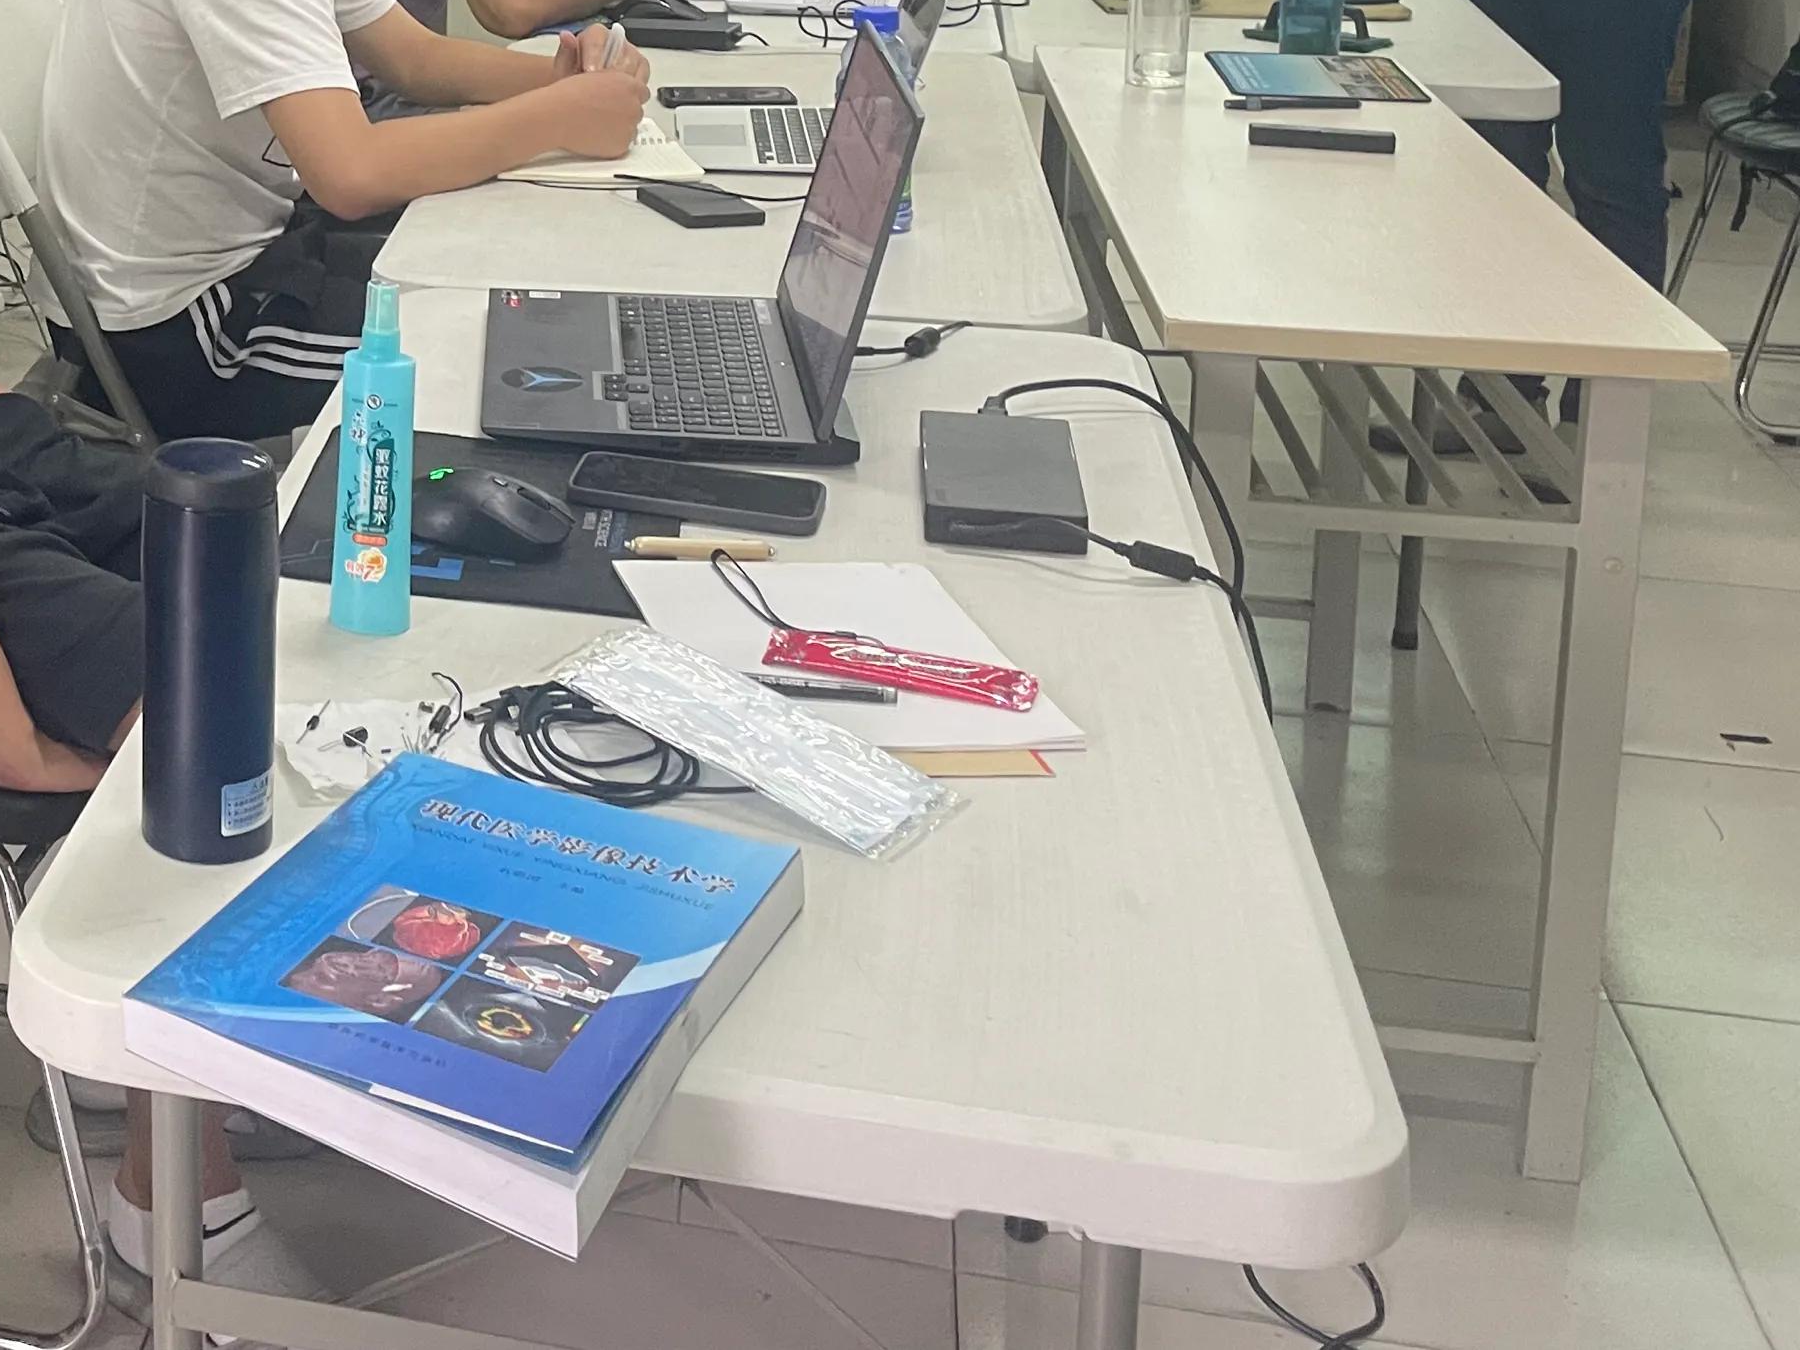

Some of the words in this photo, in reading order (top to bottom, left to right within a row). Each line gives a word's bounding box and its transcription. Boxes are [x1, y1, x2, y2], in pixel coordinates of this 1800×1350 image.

[421, 799, 739, 895] 现代医学影像技术学
